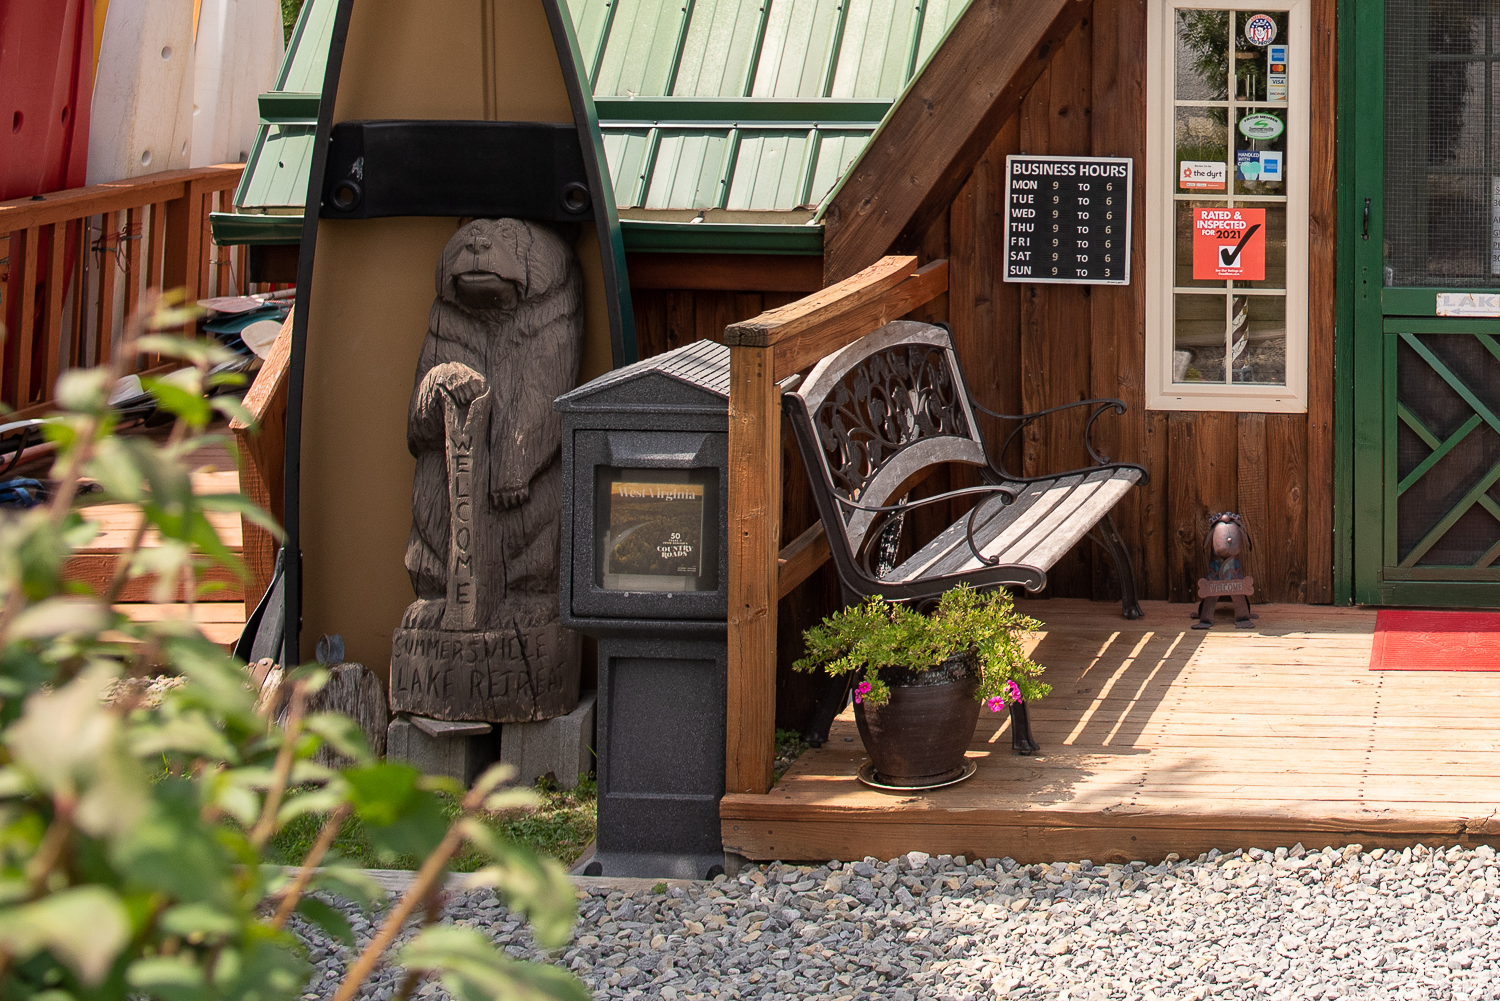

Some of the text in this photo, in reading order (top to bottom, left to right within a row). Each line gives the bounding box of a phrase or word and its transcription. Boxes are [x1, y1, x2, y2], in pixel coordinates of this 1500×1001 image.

[1012, 163, 1127, 177] BUSINESS HOURS
[1206, 170, 1223, 179] dyrt
[1012, 180, 1113, 191] MON 9 TO 6
[1011, 194, 1112, 206] TUE 9 TO 6
[1011, 208, 1113, 220] WED 9 TO 6
[1201, 210, 1242, 220] RATED &
[1011, 223, 1112, 234] THU 9 TO 6
[1196, 220, 1247, 230] INSPECTED
[1216, 230, 1241, 239] 2021
[1010, 237, 1111, 248] FRI 9 TO 6
[1010, 251, 1111, 263] SAT 9 TO 6
[1009, 266, 1111, 277] SUN 9 TO 3
[619, 486, 696, 501] West Virginia
[450, 436, 473, 605] WELCOME
[670, 532, 681, 540] 50
[661, 551, 688, 559] ROADS
[1209, 582, 1243, 593] WELCOME
[394, 633, 548, 663] SUMMERSVILLE
[397, 661, 566, 700] LAKE RETREAT
